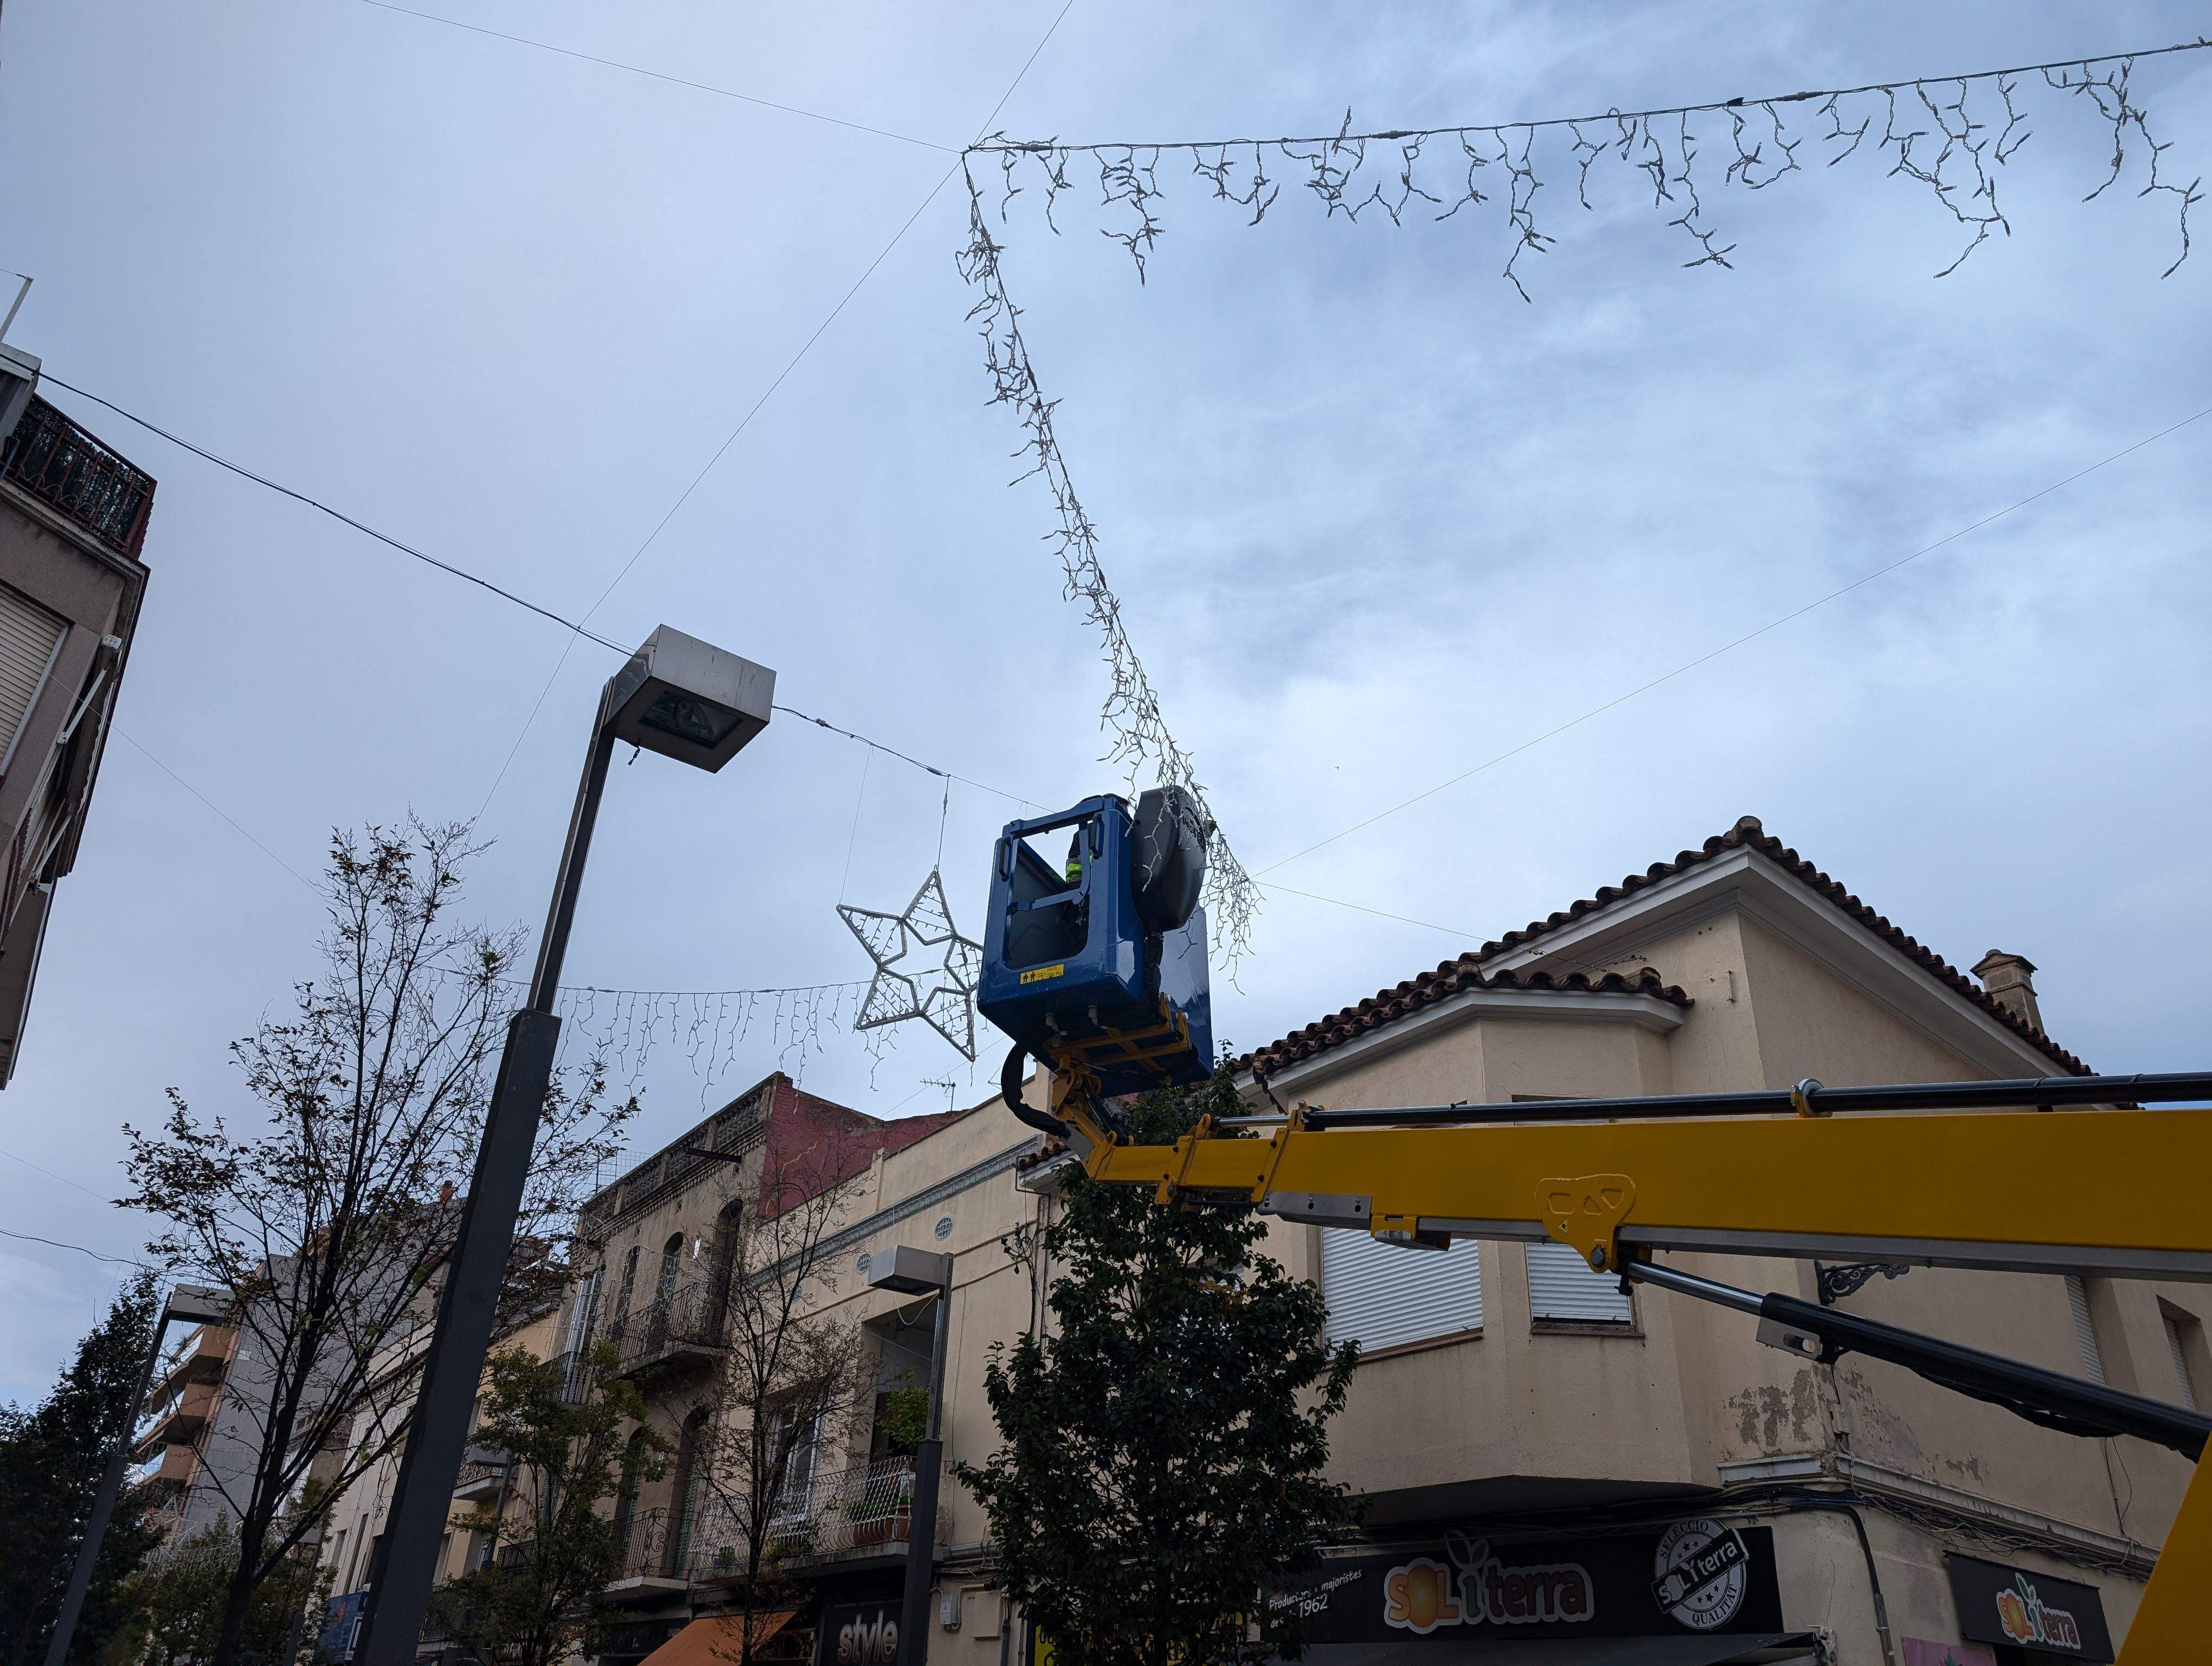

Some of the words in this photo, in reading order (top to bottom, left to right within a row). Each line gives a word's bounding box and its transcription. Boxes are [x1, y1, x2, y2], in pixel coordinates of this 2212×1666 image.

[1321, 1569, 1362, 1592] majoristes
[1299, 1593, 1328, 1618] 1962
[1692, 1583, 1738, 1626] QUALITAT
[837, 1609, 898, 1666] style
